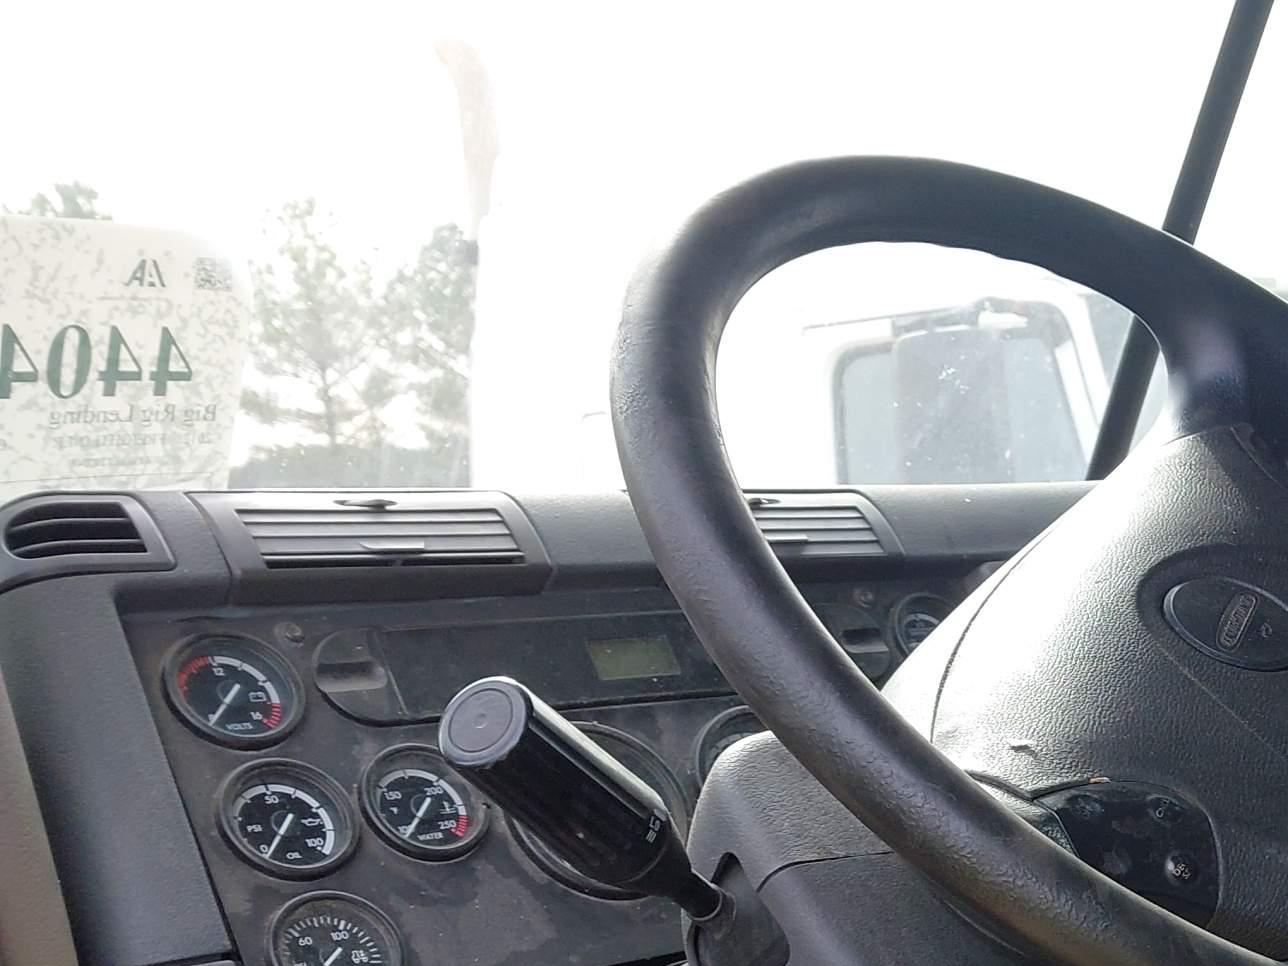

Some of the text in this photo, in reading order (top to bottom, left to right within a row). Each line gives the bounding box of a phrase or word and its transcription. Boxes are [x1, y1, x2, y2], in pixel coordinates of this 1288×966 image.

[212, 667, 225, 676] 12
[250, 711, 263, 720] 16
[384, 791, 402, 800] 150
[424, 786, 444, 796] 200
[264, 795, 279, 804] 50
[437, 820, 456, 829] 250
[305, 837, 324, 847] 100
[260, 844, 268, 853] 0
[286, 852, 302, 860] OIL
[330, 930, 349, 941] 100
[298, 936, 312, 946] 60
